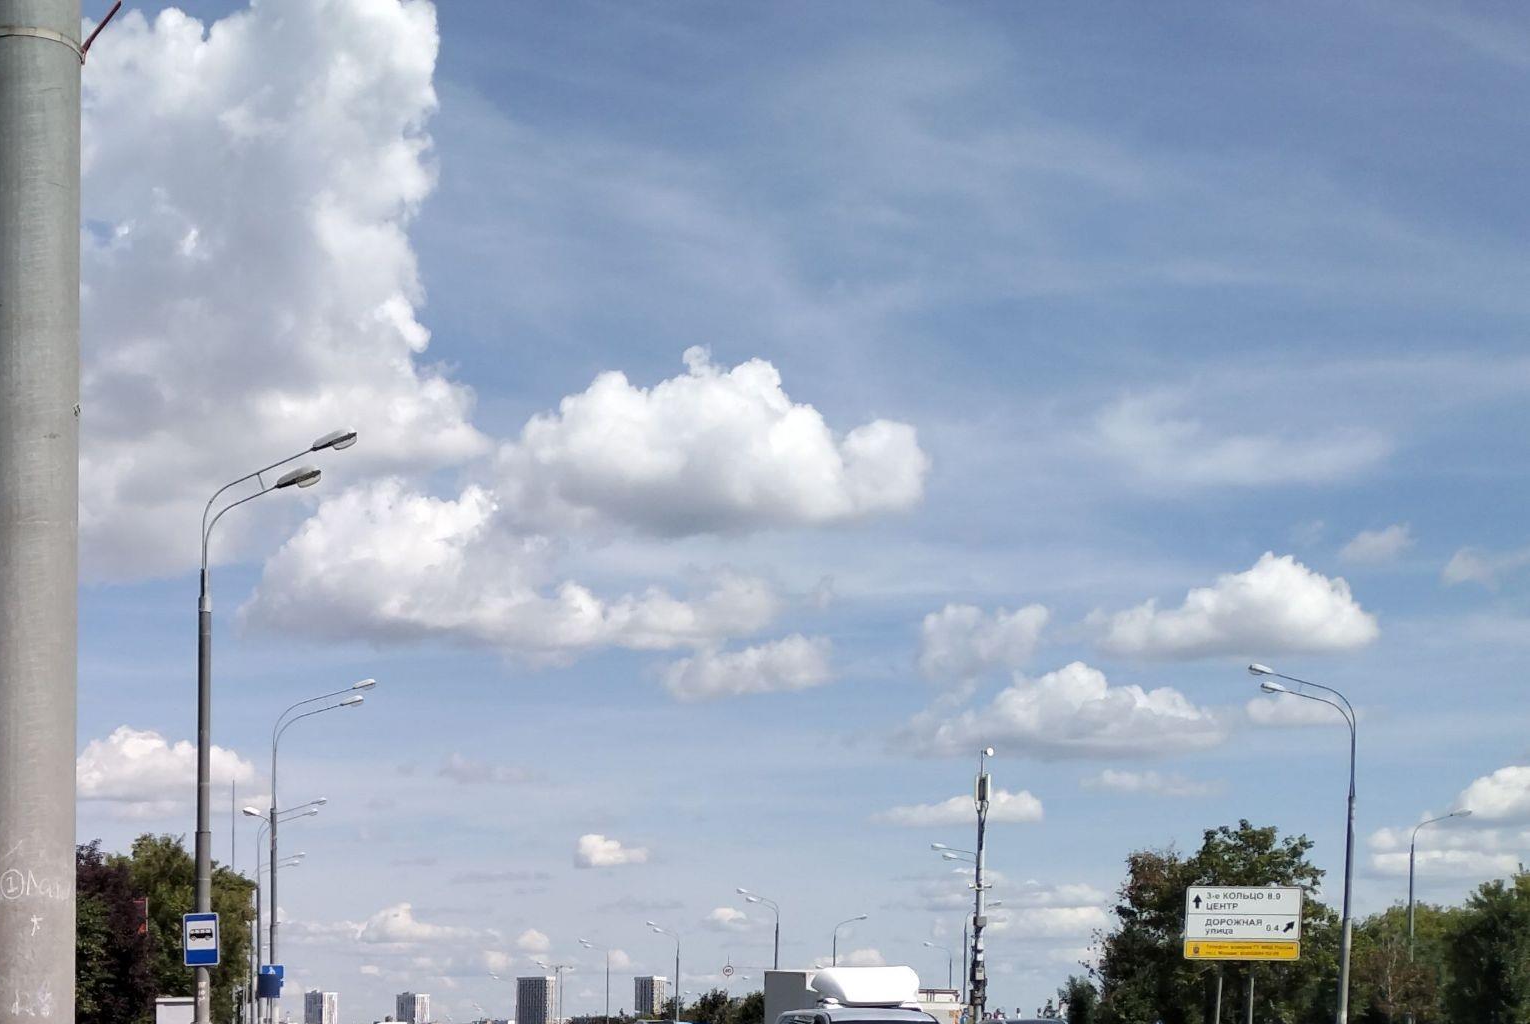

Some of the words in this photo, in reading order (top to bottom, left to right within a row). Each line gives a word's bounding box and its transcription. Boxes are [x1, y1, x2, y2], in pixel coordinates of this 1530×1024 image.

[1223, 892, 1264, 901] КОЛЬЦО
[1206, 902, 1239, 911] ЦЕНТР
[1205, 918, 1263, 926] ДОРОЖНАЯ
